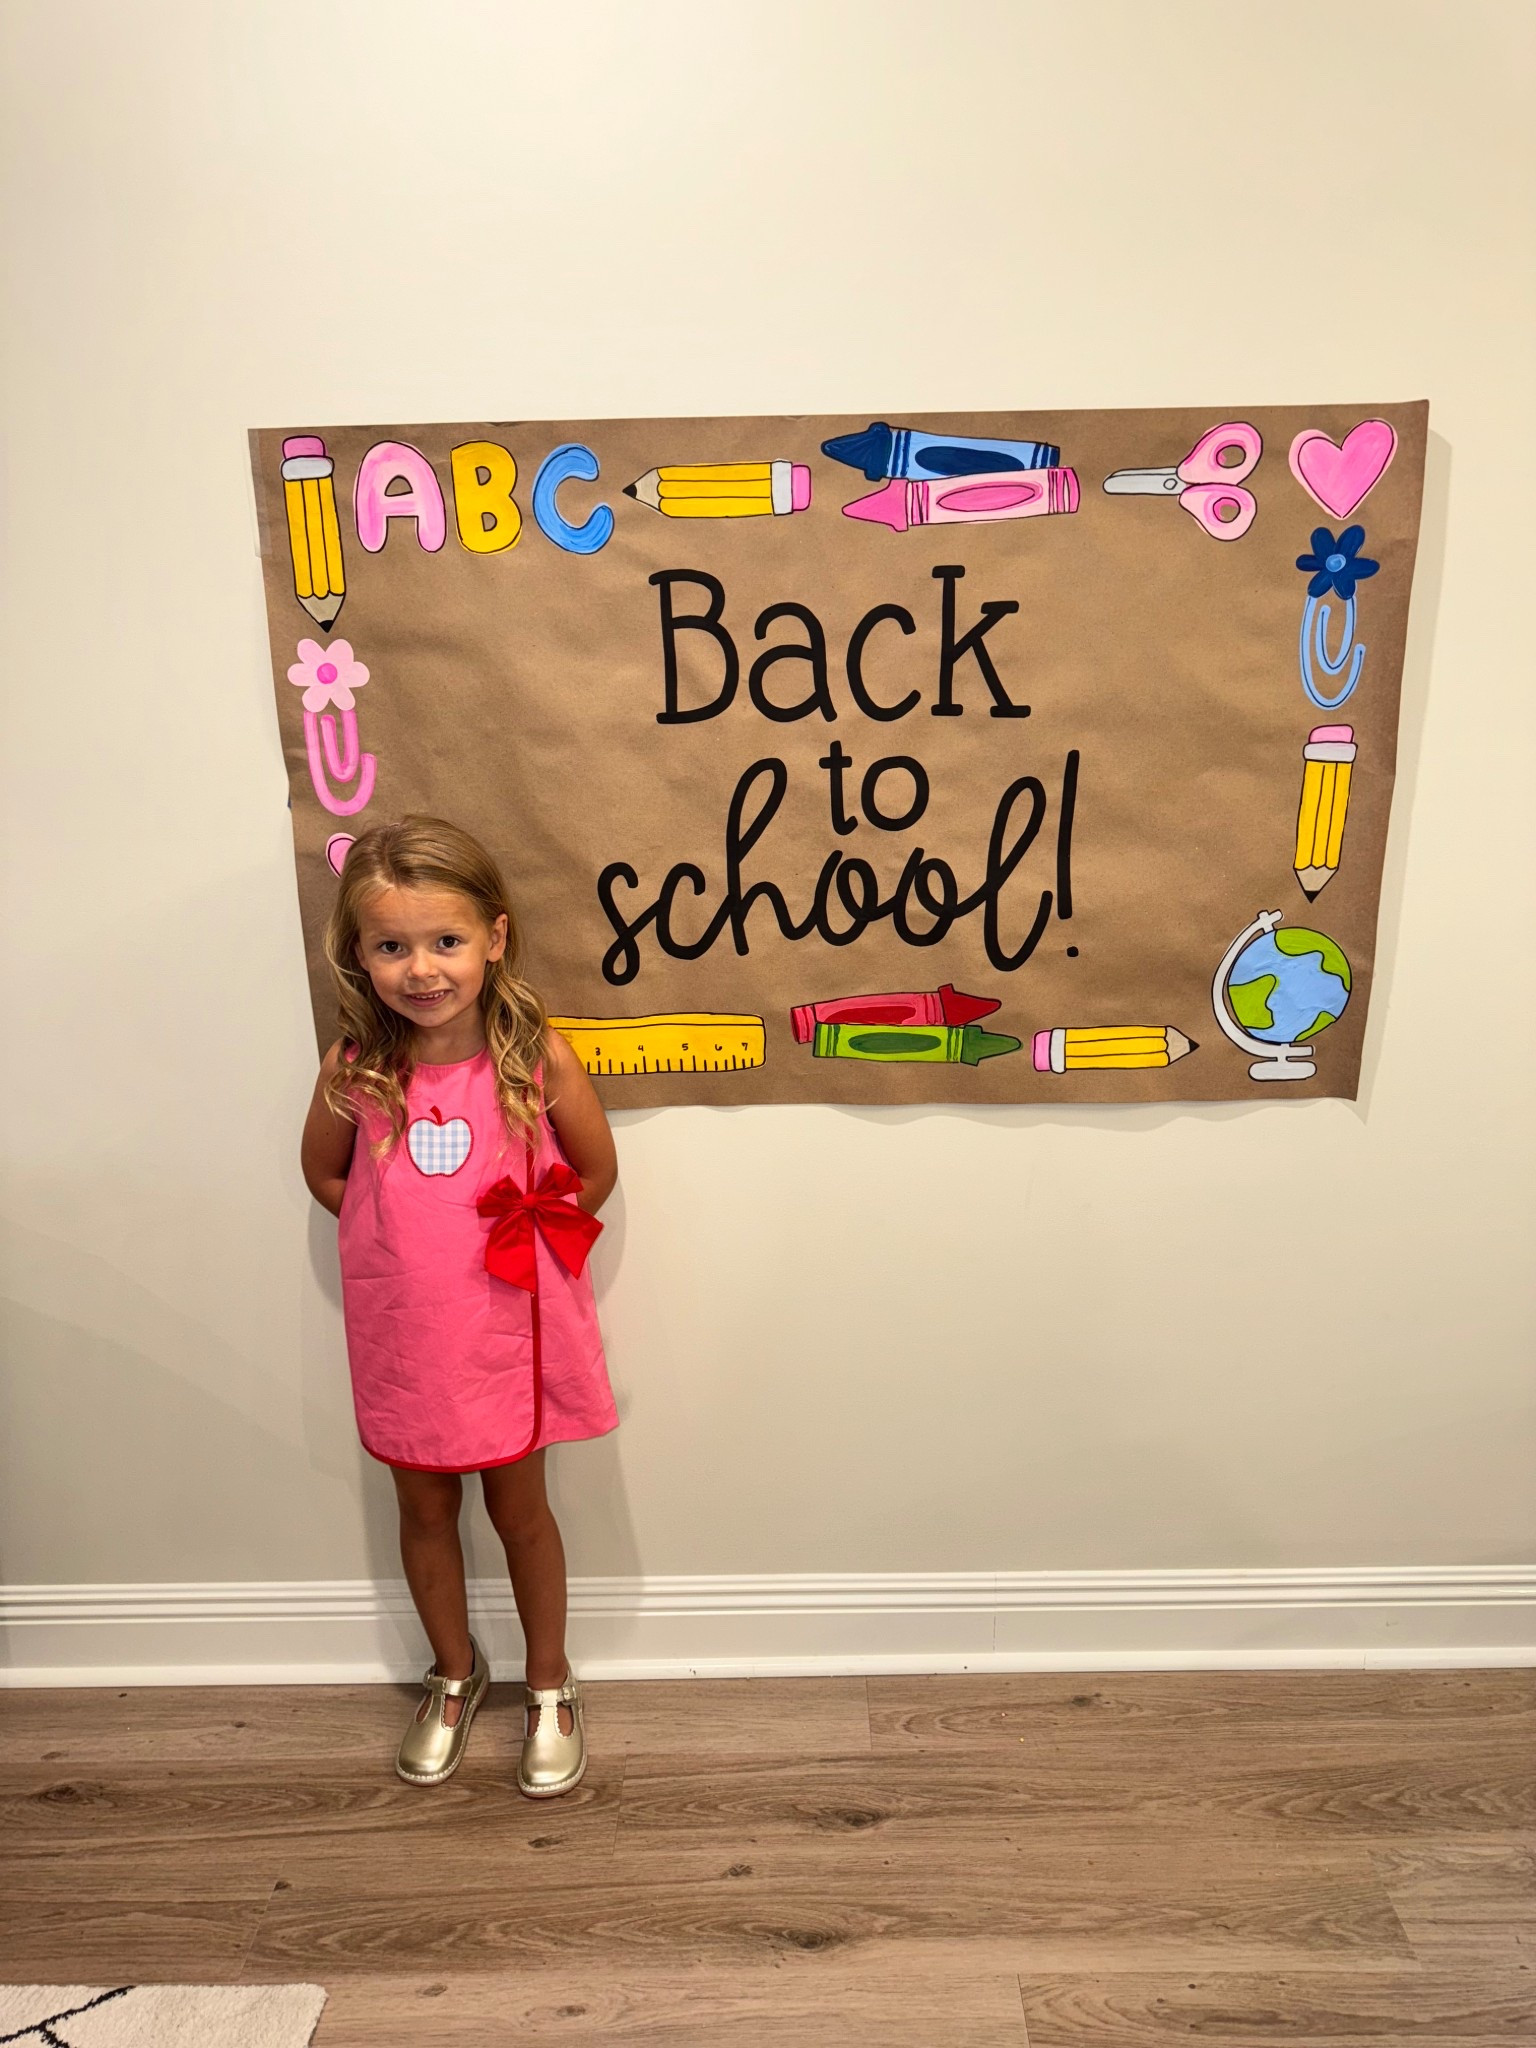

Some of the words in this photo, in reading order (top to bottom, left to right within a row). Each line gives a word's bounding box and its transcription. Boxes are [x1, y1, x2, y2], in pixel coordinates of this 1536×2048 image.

[354, 440, 615, 556] ABC
[648, 565, 1031, 725] Back
[818, 740, 930, 836] to
[597, 749, 1080, 987] school!
[595, 1047, 601, 1056] 3
[681, 1043, 689, 1051] 5
[714, 1043, 723, 1051] 6
[741, 1042, 749, 1051] 7
